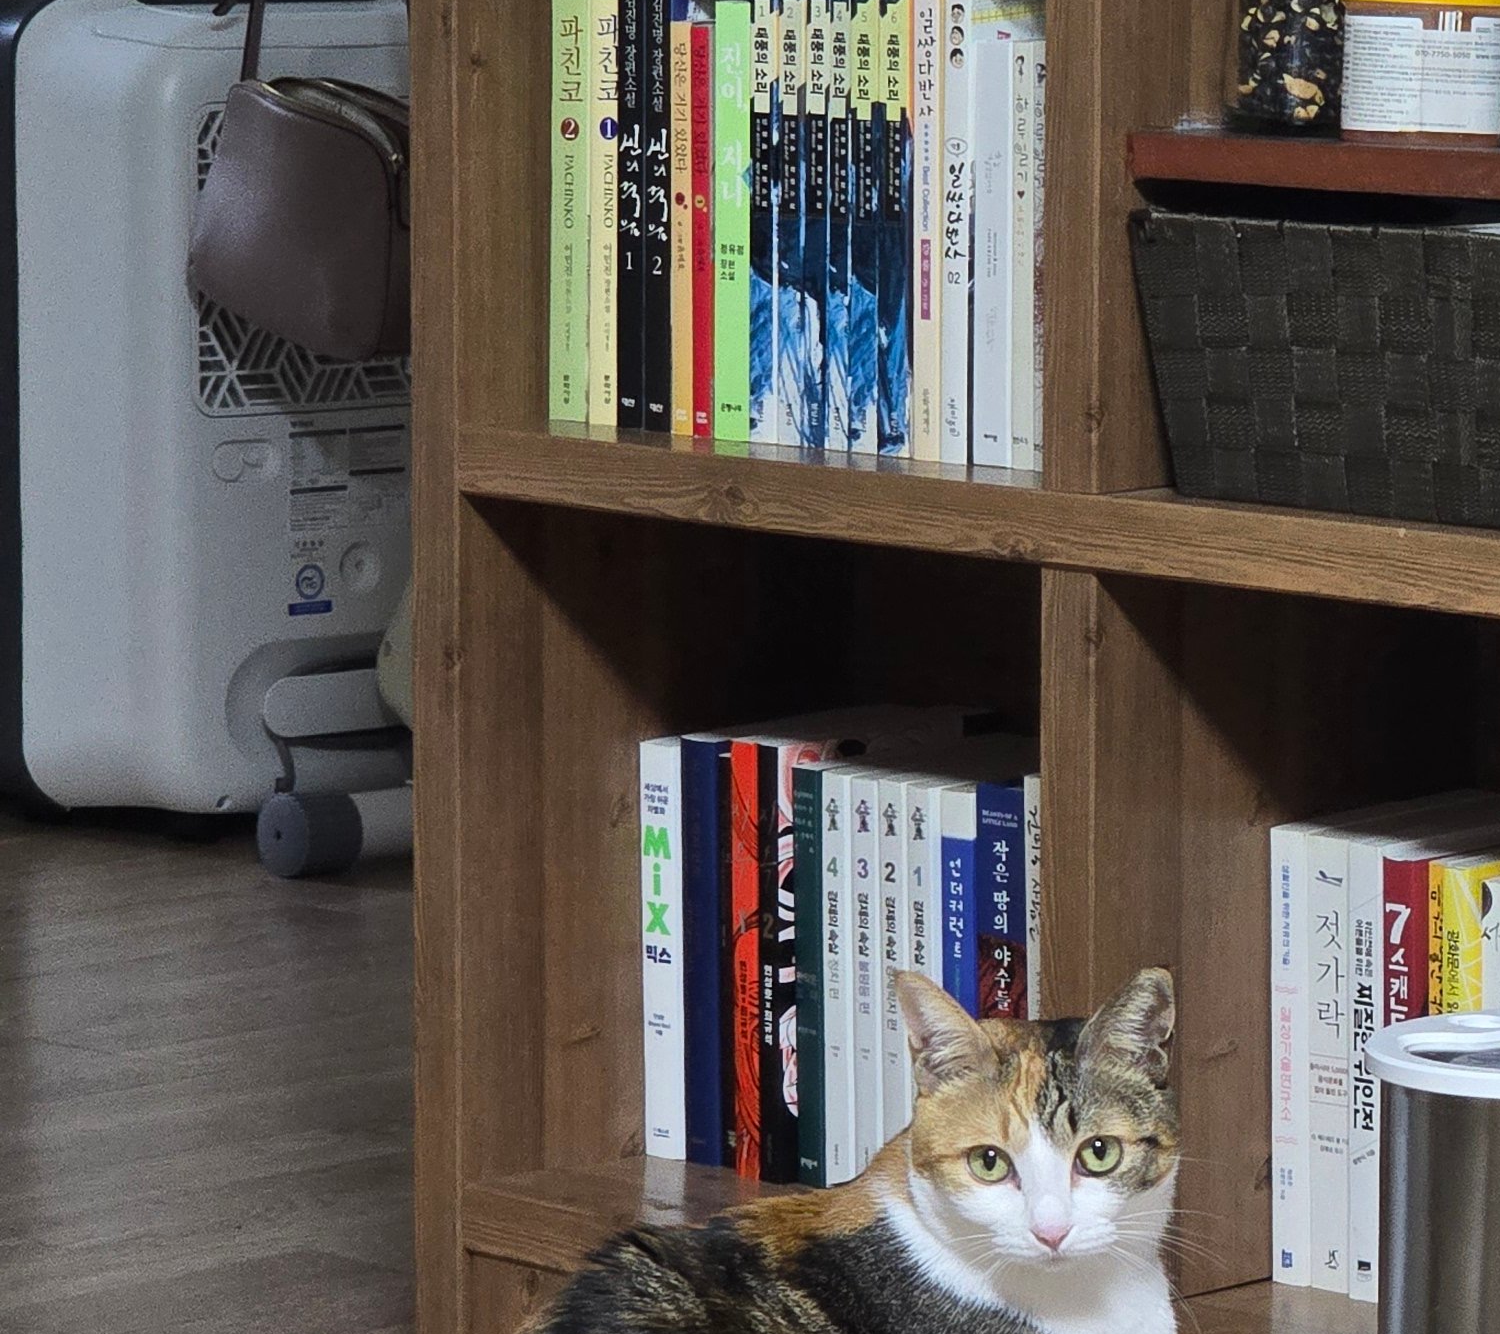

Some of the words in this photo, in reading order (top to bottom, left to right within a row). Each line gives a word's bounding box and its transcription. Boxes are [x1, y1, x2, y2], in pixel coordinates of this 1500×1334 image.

[559, 14, 585, 105] 파친코
[596, 13, 619, 104] 파친코
[755, 27, 768, 64] 태풍의
[783, 29, 796, 66] 태풍의
[624, 45, 638, 109] 장편소설
[651, 49, 665, 113] 장편소설
[755, 68, 768, 95] 소리
[783, 70, 796, 96] 소리
[562, 155, 574, 229] PACHINKO
[651, 256, 662, 275] 2
[643, 825, 672, 936] MiX
[992, 839, 1009, 883] 작은
[949, 857, 964, 958] 언더커런트
[993, 890, 1010, 935] 땅의
[1385, 903, 1411, 944] 7
[646, 946, 672, 965] 믹스
[993, 945, 1012, 1011] 야수들
[1316, 908, 1347, 1039] 젓가락
